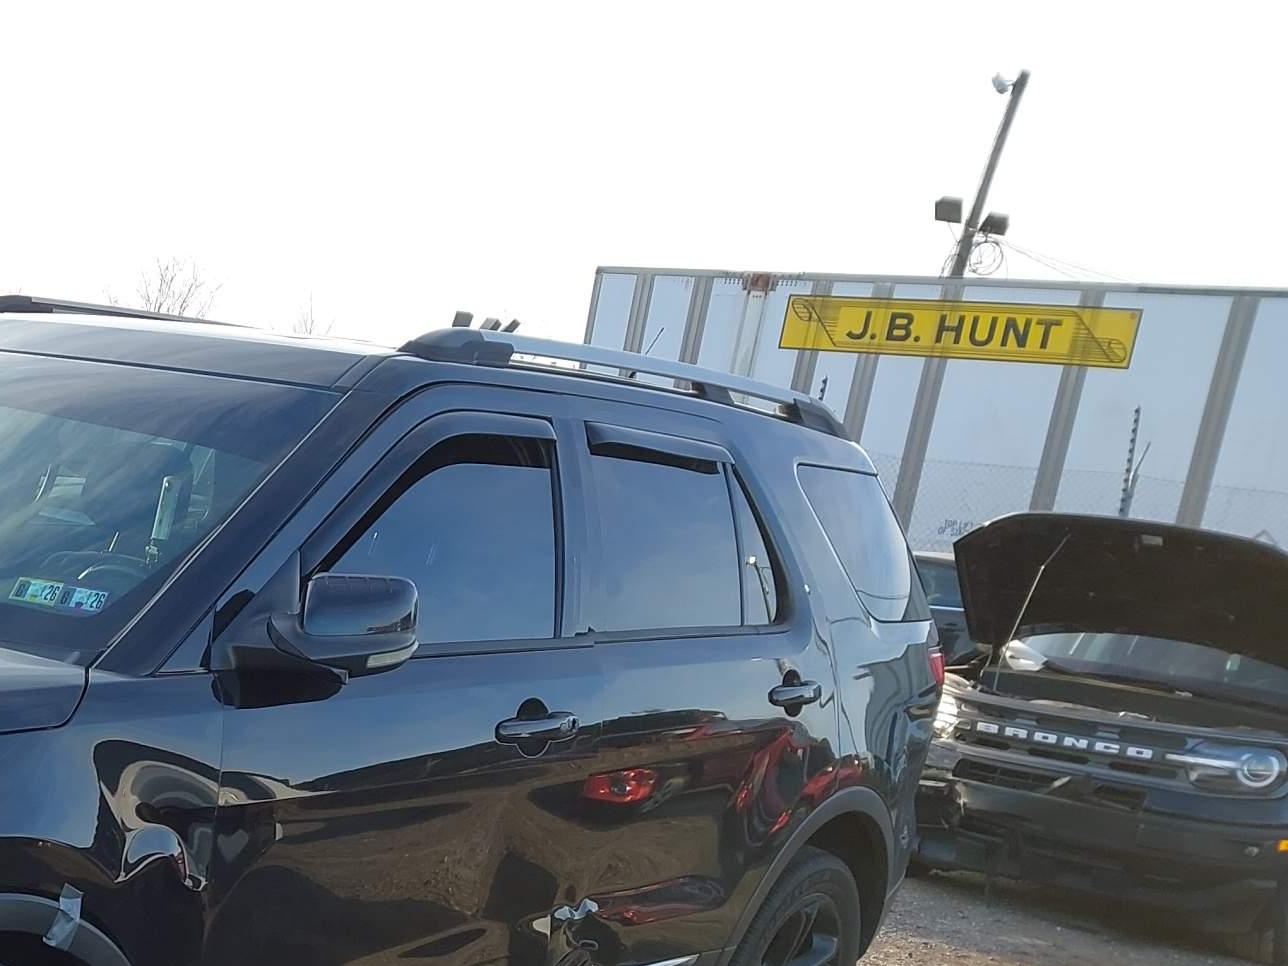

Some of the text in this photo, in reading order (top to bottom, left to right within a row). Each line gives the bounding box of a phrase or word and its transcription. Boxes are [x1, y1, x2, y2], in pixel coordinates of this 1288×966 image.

[934, 314, 1065, 350] HUNT
[43, 585, 60, 602] 26
[89, 592, 106, 609] 26
[976, 721, 1153, 760] BRONCO
